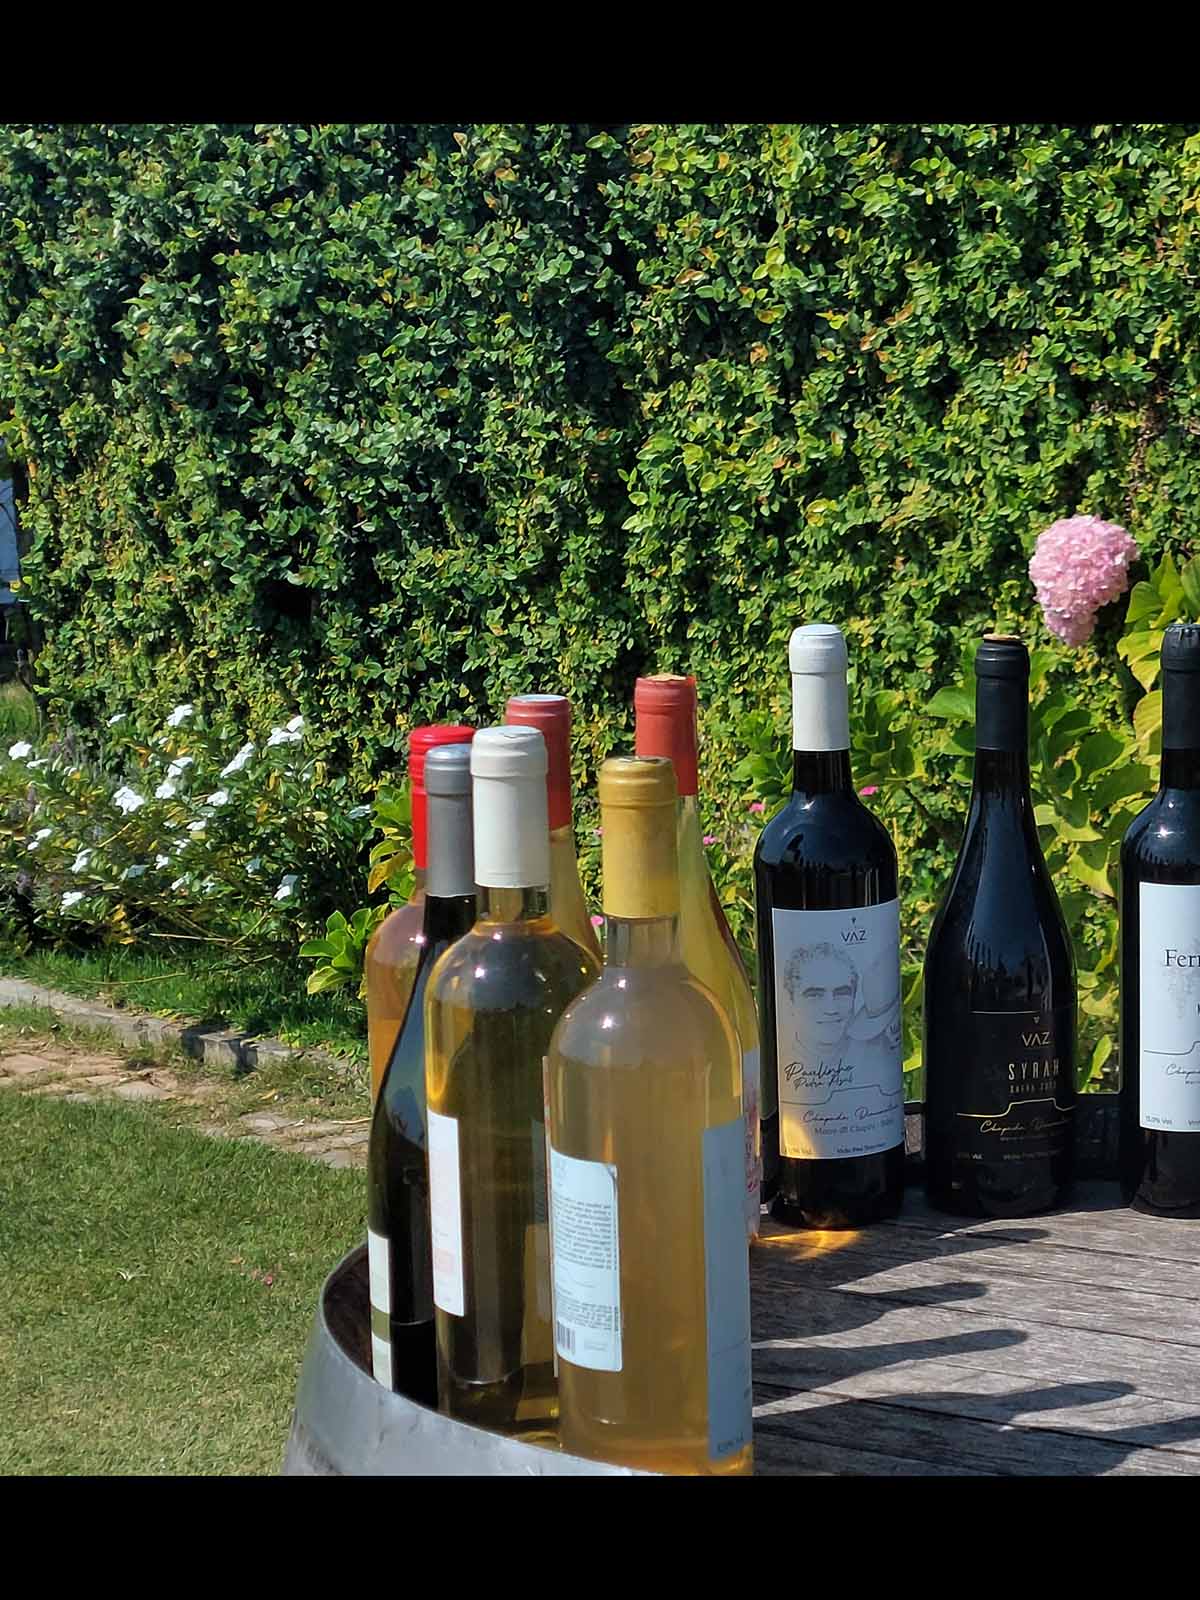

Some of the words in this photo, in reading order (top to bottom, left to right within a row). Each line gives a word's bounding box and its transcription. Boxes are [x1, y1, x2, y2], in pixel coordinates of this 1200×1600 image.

[840, 930, 868, 942] VAZ
[1021, 1031, 1051, 1047] VAZ
[1008, 1059, 1060, 1081] SYRAH
